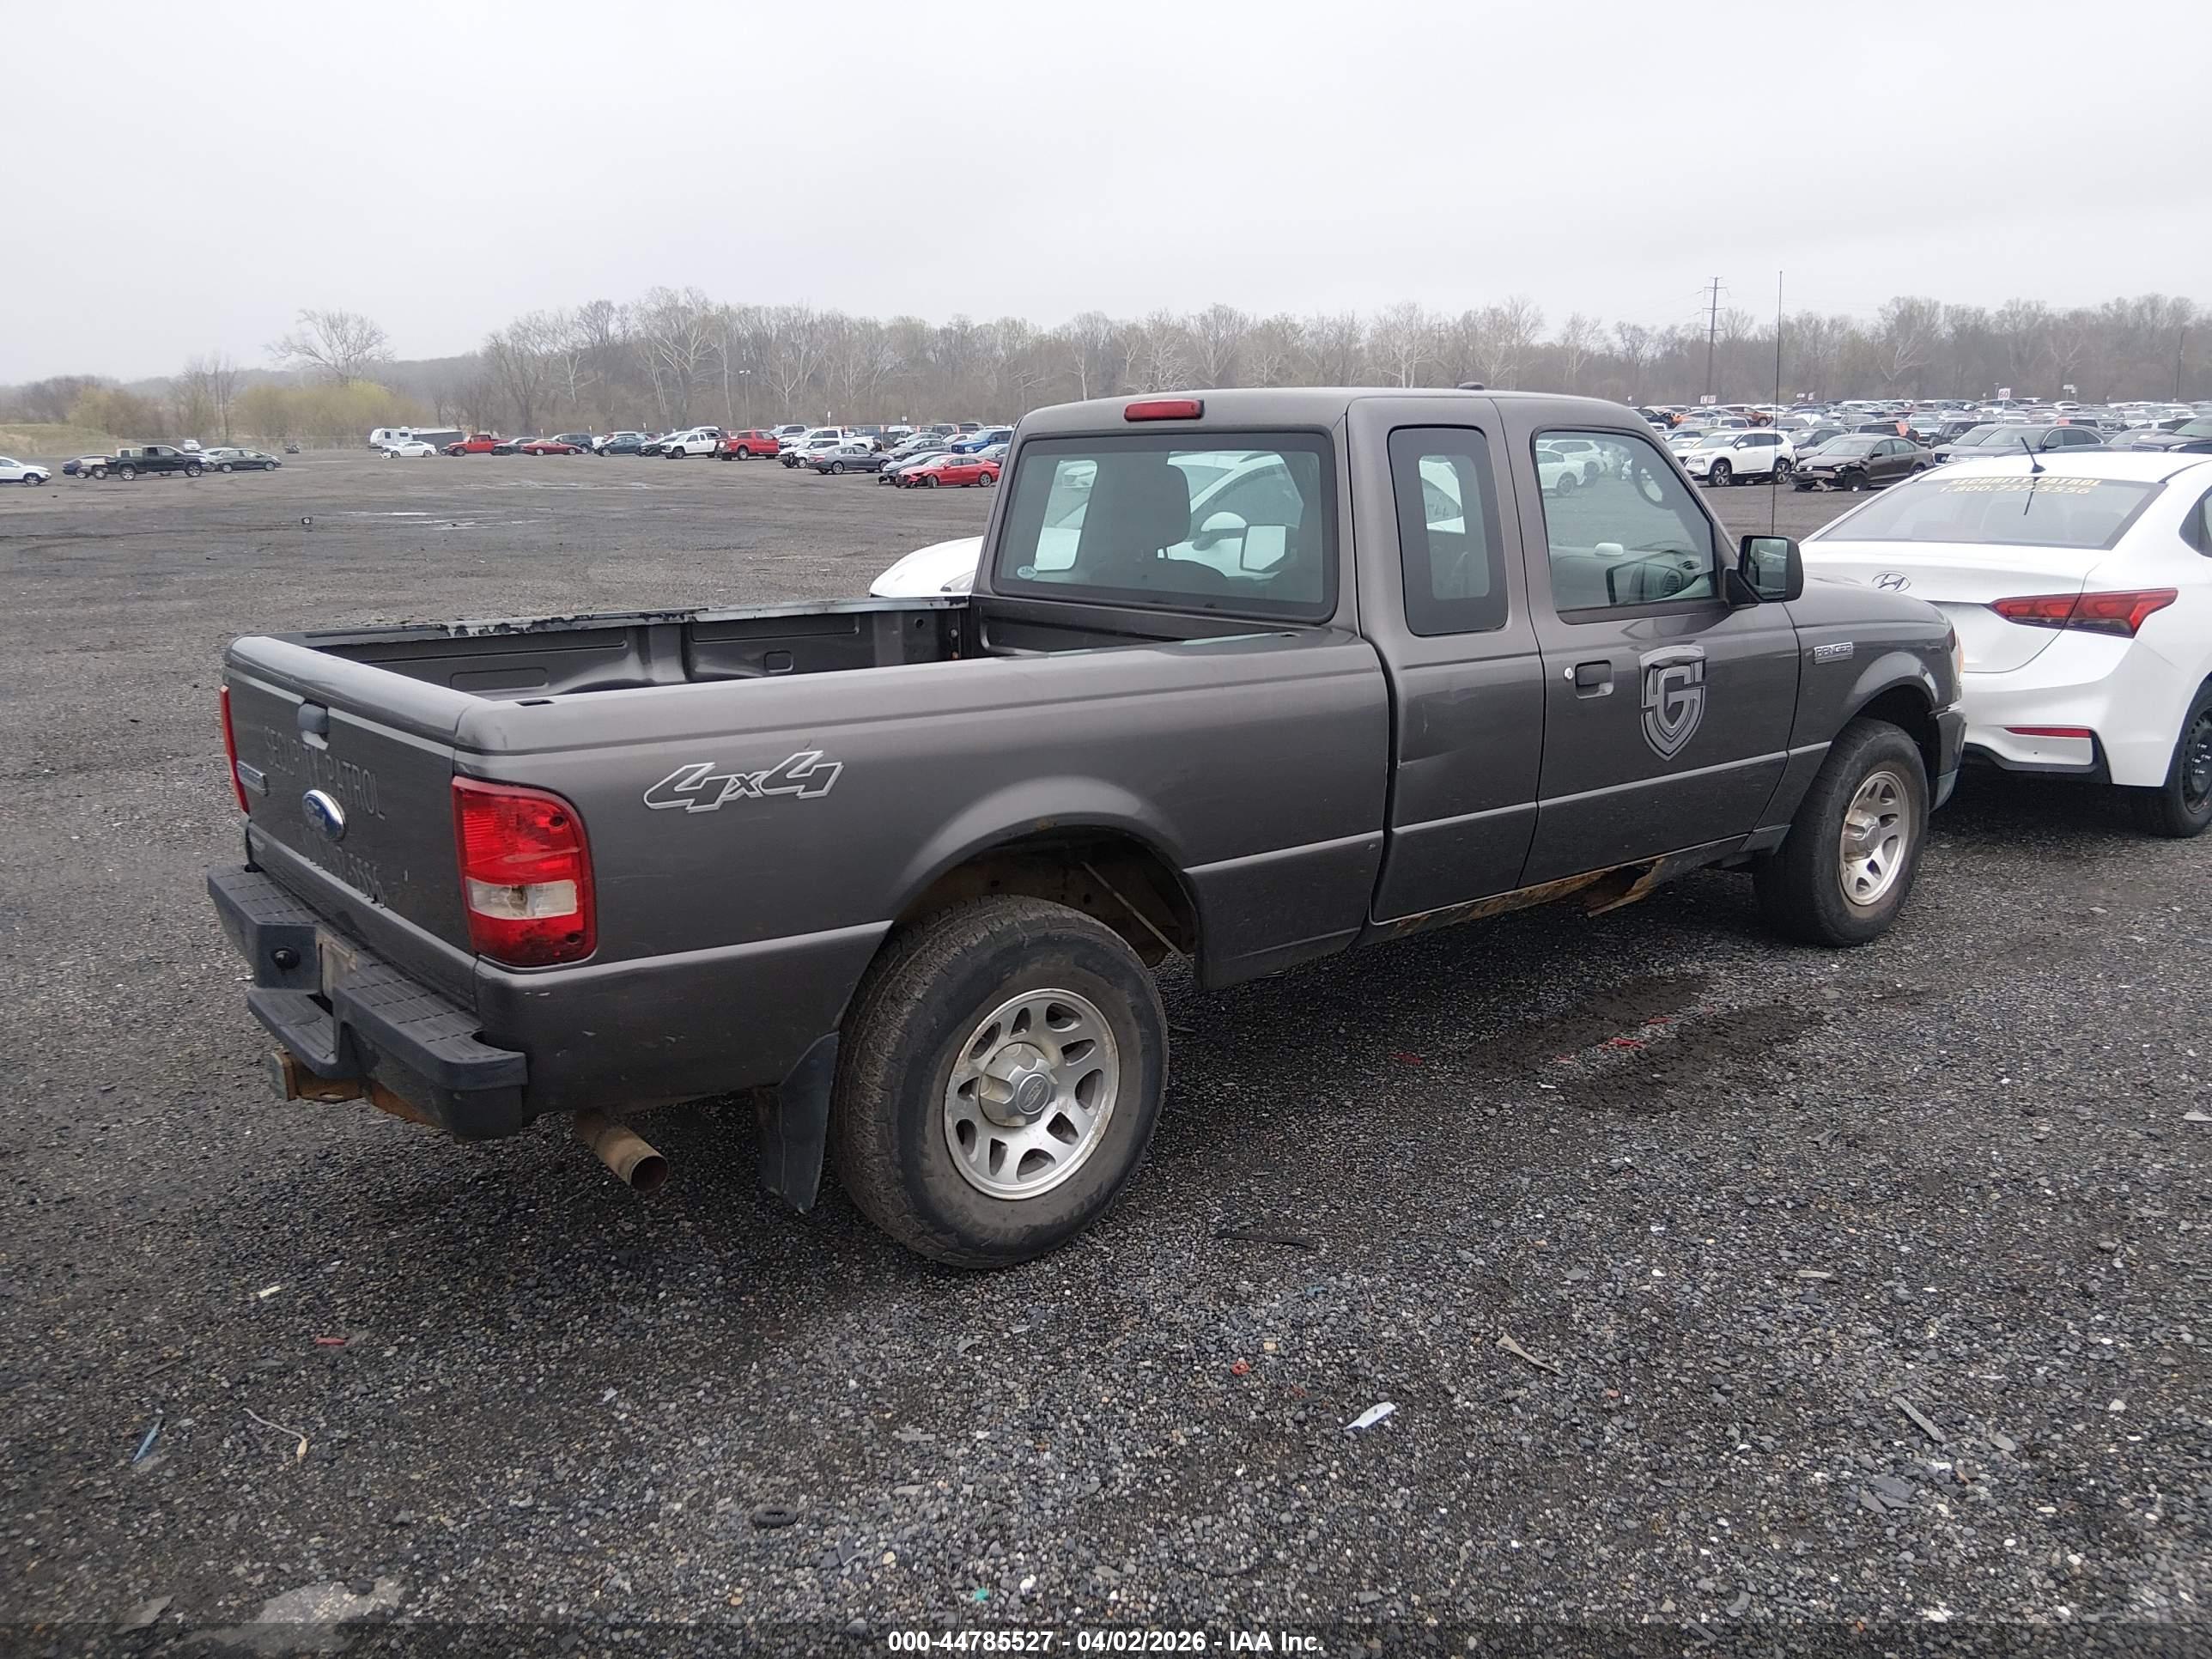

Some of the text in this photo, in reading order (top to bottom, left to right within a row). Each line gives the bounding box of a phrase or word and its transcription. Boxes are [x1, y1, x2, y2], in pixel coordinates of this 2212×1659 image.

[1948, 477, 2103, 487] SECURITY PATROL
[1814, 644, 1853, 659] RANGER
[324, 753, 386, 821] PATROL
